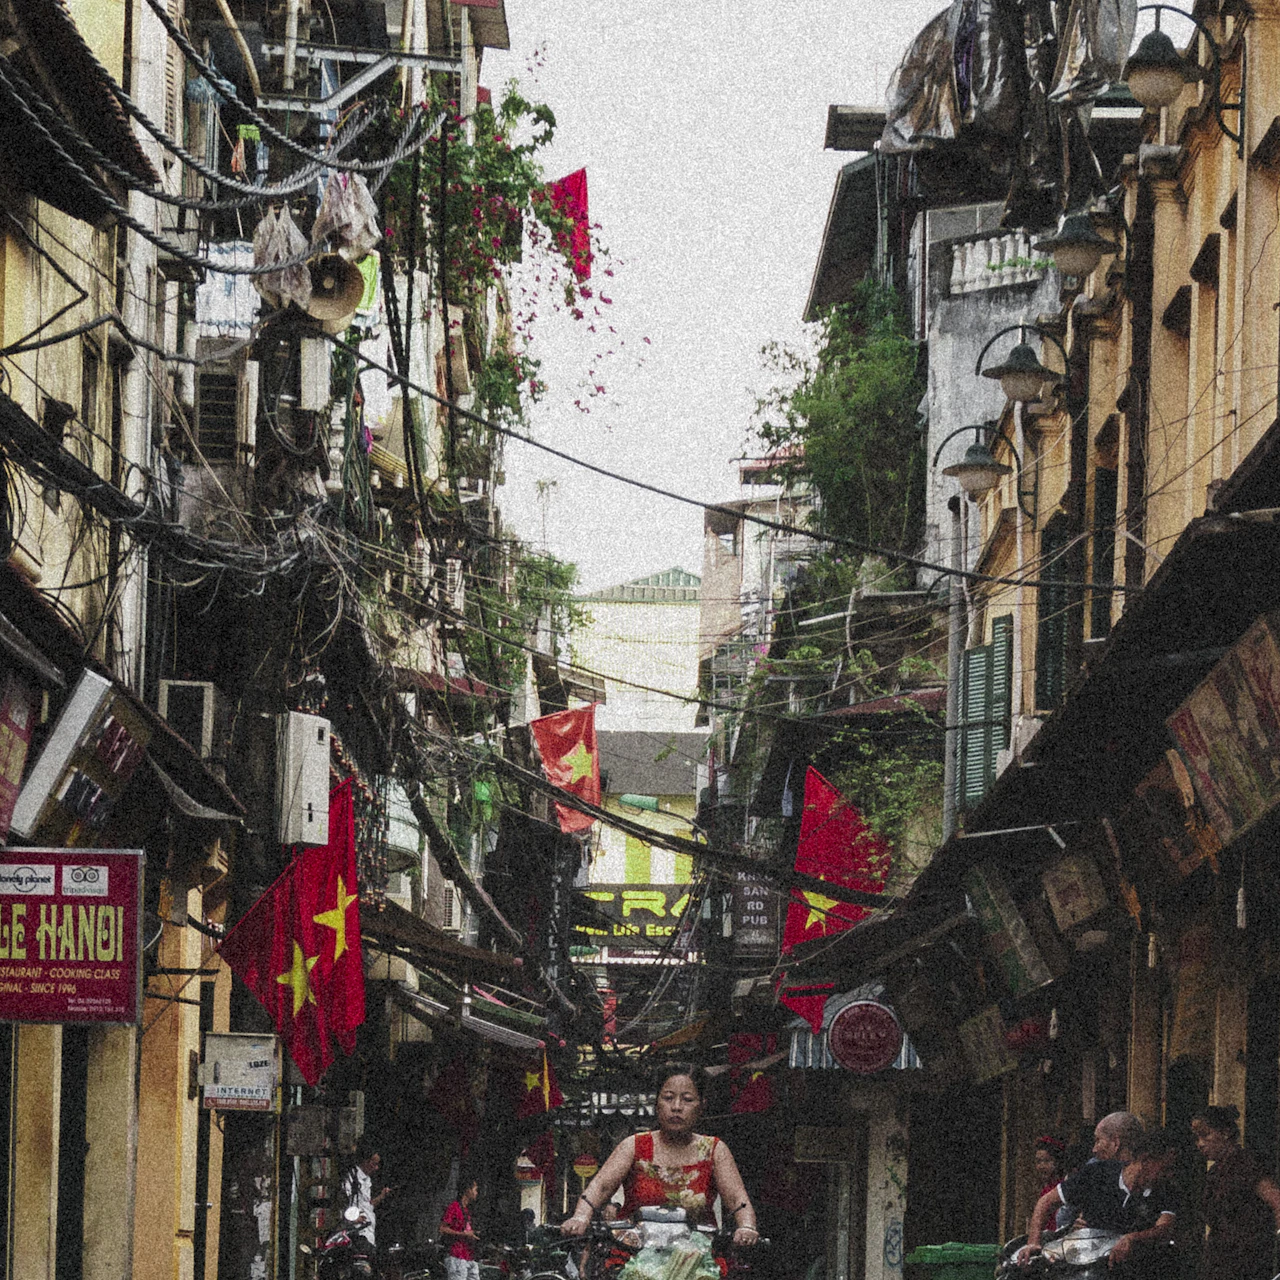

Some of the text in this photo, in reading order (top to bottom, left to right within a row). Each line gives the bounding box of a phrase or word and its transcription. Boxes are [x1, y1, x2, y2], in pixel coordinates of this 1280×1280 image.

[24, 873, 52, 885] planet
[743, 886, 769, 896] SAN
[746, 900, 765, 911] RD
[742, 915, 769, 925] PUB
[35, 904, 125, 962] HANOI
[49, 967, 92, 979] COOKING
[93, 968, 121, 980] CLASS
[30, 982, 56, 994] SINCE
[57, 983, 77, 995] 1996
